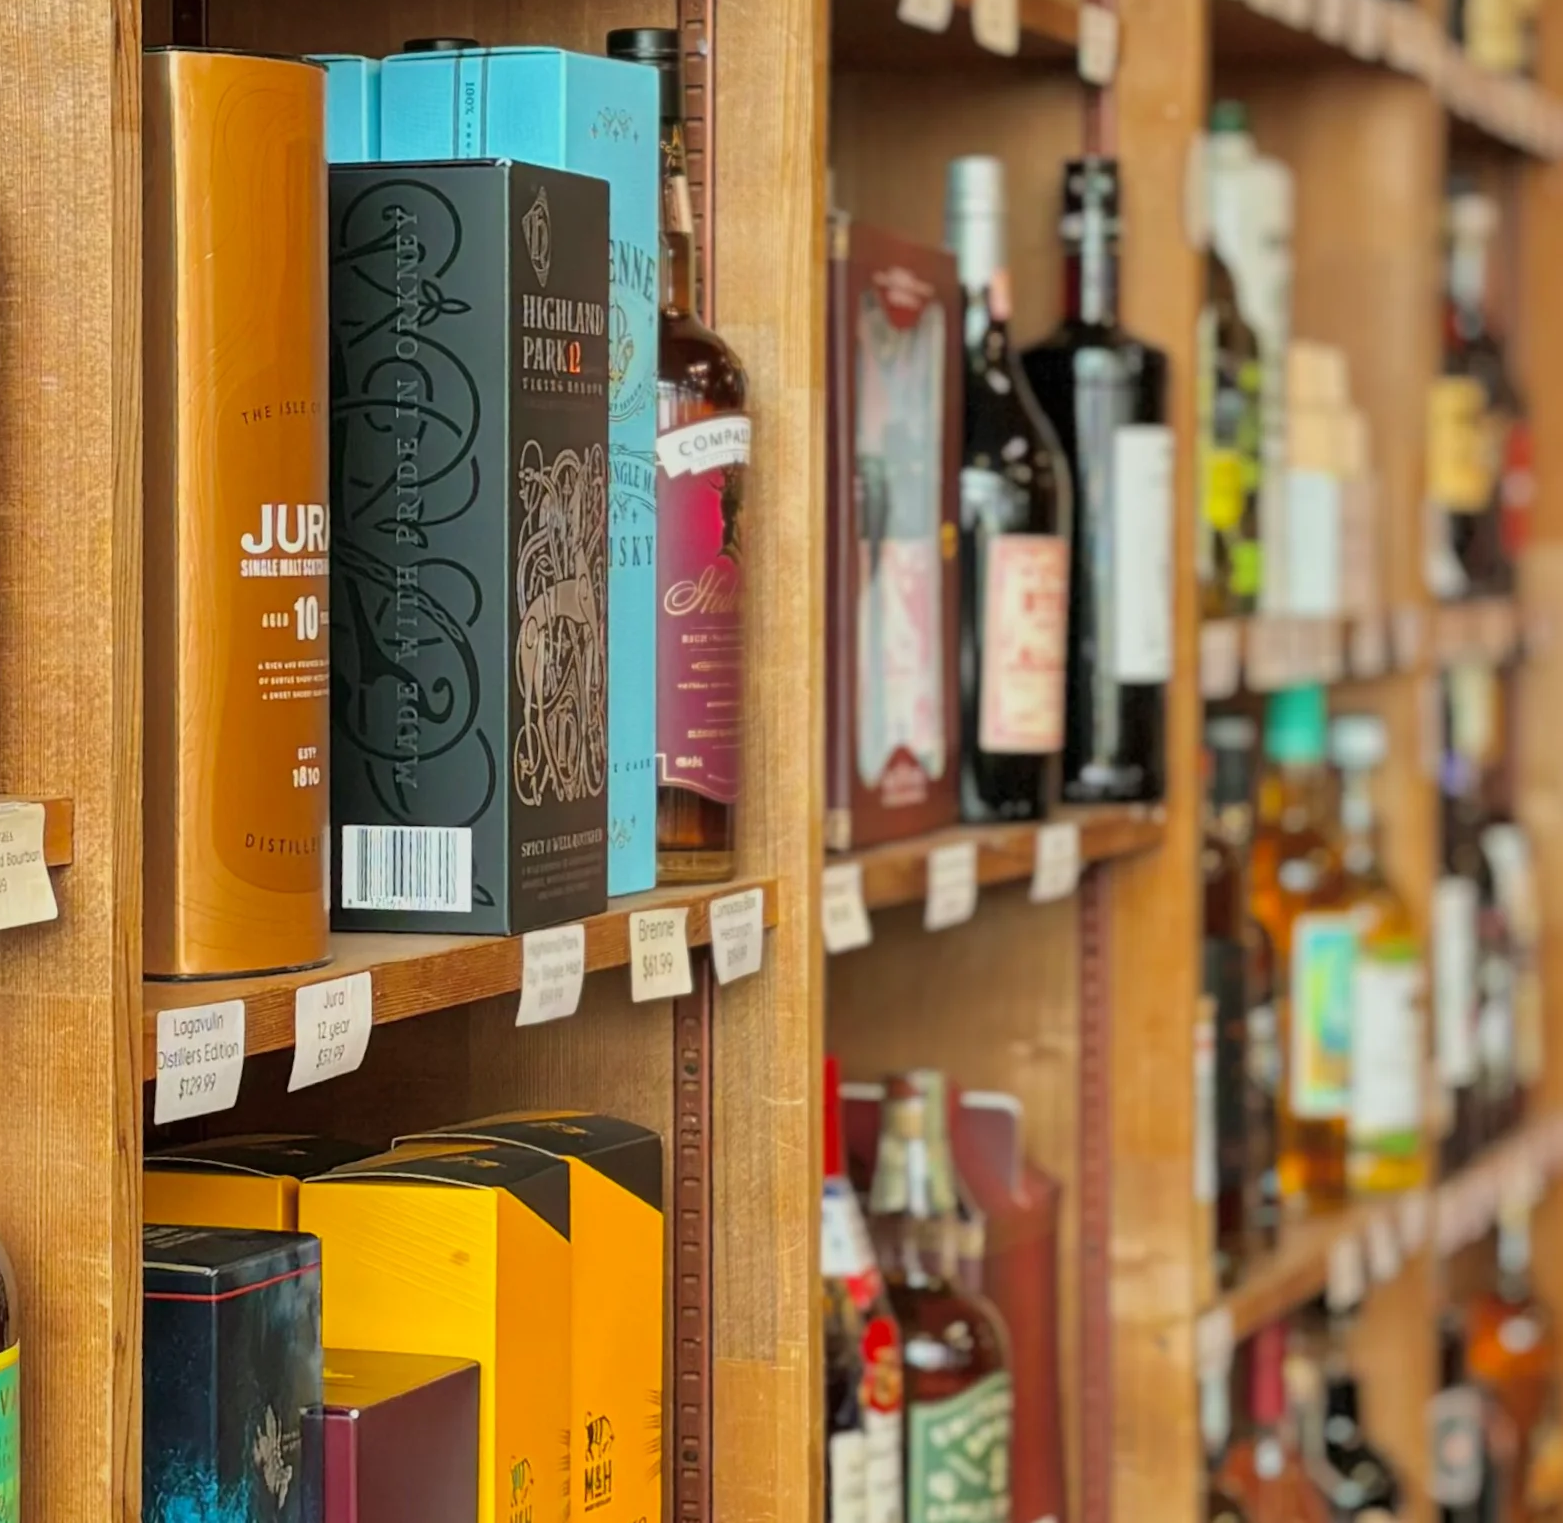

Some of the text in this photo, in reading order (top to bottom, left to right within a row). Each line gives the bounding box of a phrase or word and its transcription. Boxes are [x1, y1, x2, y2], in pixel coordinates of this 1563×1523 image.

[522, 293, 605, 337] HIGHLAND
[522, 335, 568, 376] PARK
[278, 400, 307, 418] ISLE
[394, 207, 422, 790] MADE WITH PRIDE IN ORKNEY
[240, 558, 302, 577] SINGLE MALT
[293, 595, 319, 642] 10
[292, 765, 320, 788] 1810
[6, 849, 42, 869] Bourbon
[638, 918, 676, 943] Brenne
[322, 989, 346, 1010] Jura
[173, 1011, 224, 1040] Lagavulin
[317, 1018, 351, 1041] 12 year
[157, 1040, 239, 1071] Distillers Edition
[178, 1072, 217, 1099] $129.99
[583, 1459, 614, 1504] M&H
